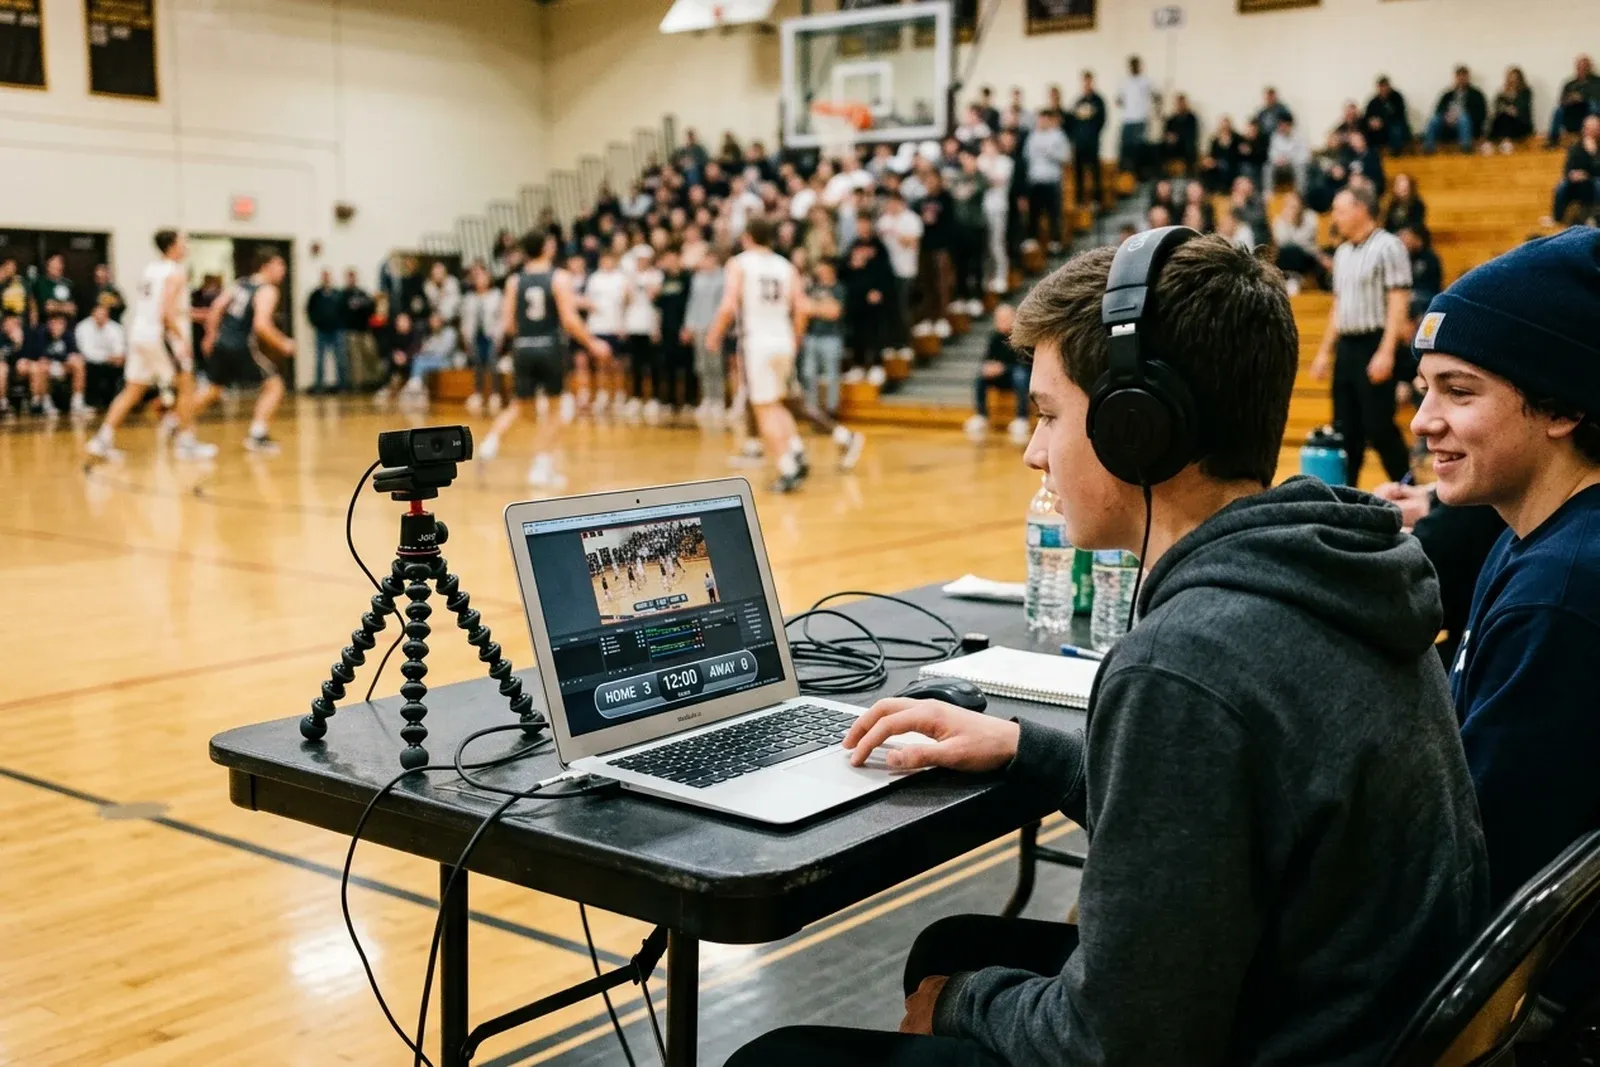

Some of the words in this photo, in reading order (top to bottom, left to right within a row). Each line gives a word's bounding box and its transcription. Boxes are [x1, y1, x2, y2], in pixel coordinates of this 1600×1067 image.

[524, 286, 546, 321] 3
[605, 685, 637, 704] HOME
[642, 681, 652, 695] 3
[662, 668, 698, 691] 12:00
[709, 660, 736, 678] AWAY
